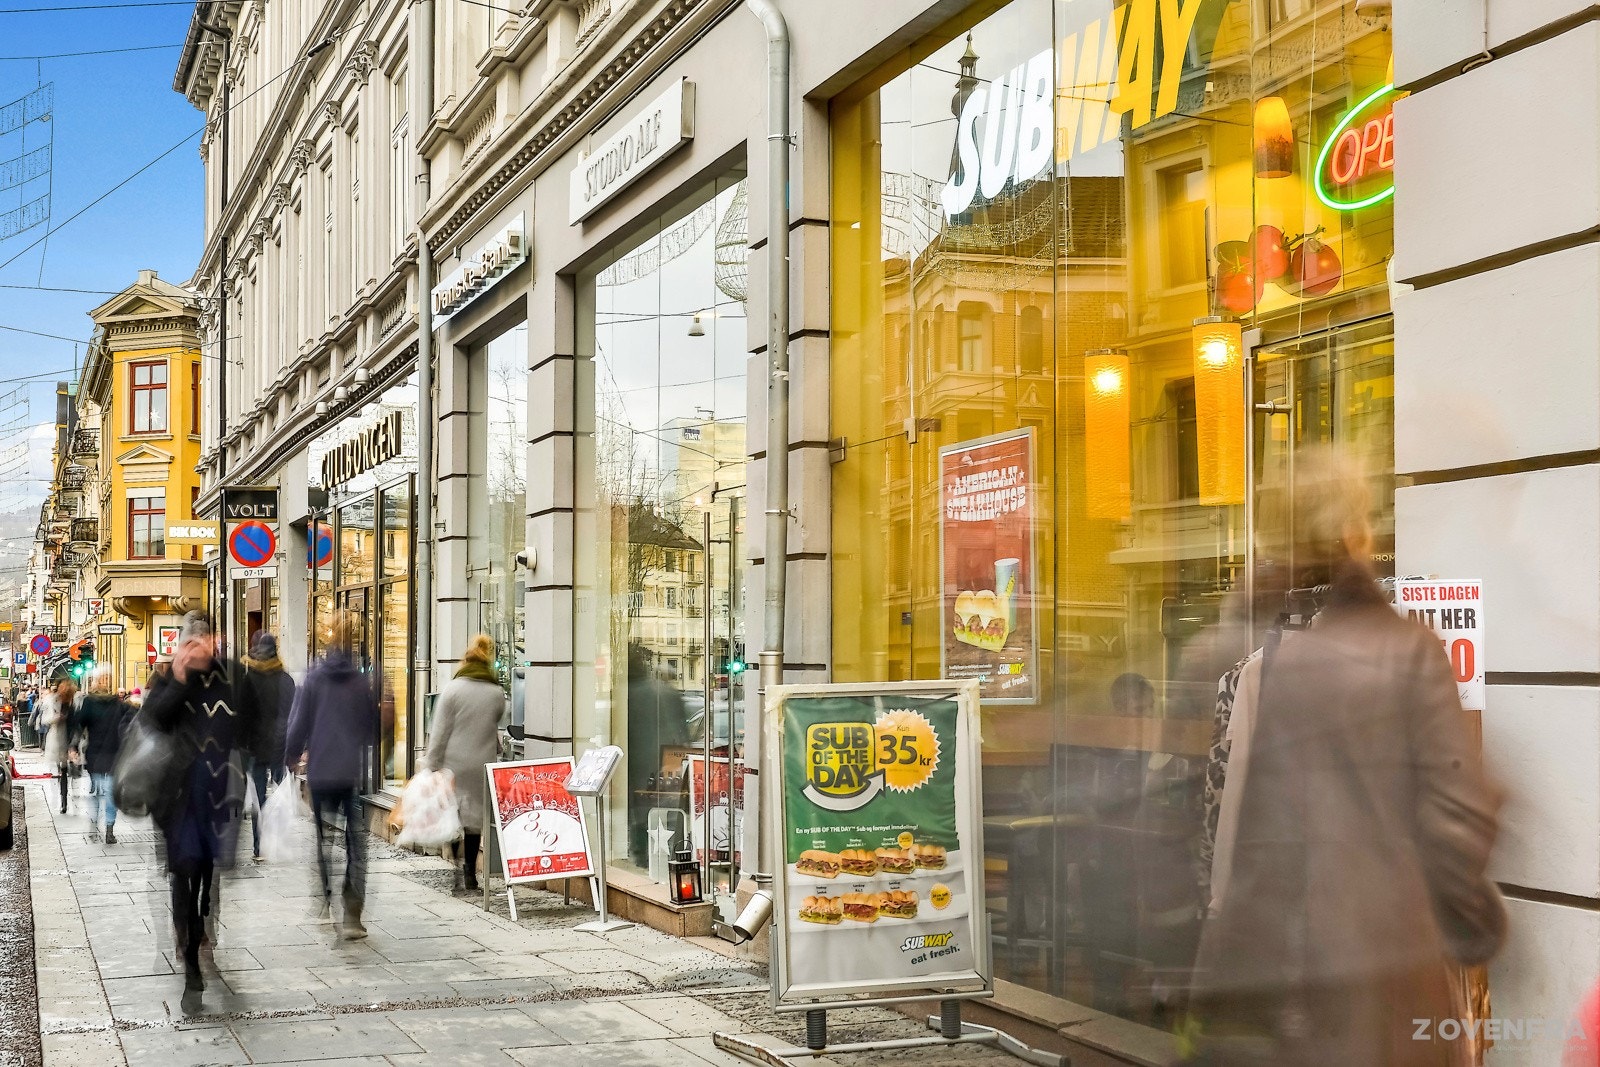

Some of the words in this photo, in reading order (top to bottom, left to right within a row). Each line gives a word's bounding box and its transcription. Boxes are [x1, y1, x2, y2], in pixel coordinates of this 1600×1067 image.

[940, 0, 1203, 217] SUBWAY
[584, 134, 634, 203] STUDIO
[432, 267, 480, 315] Danske
[481, 230, 520, 278] Bank
[321, 411, 401, 492] GULLBORGEN
[953, 465, 1018, 496] AMERICAN
[227, 503, 275, 517] VOLT
[946, 486, 1026, 521] STEAKHOUSE
[243, 569, 264, 577] 07-17
[1402, 586, 1437, 602] SISTE
[1439, 585, 1479, 601] DAGEN
[1441, 608, 1476, 630] HER
[812, 726, 870, 750] SUB
[878, 734, 918, 765] 35
[919, 754, 932, 766] kr
[812, 751, 833, 765] OF
[835, 749, 869, 765] THE
[813, 763, 870, 788] DAY
[523, 811, 541, 832] 3
[541, 832, 559, 853] 2
[900, 931, 954, 952] SUBWAY
[910, 952, 928, 965] eat
[929, 944, 961, 959] fresh.
